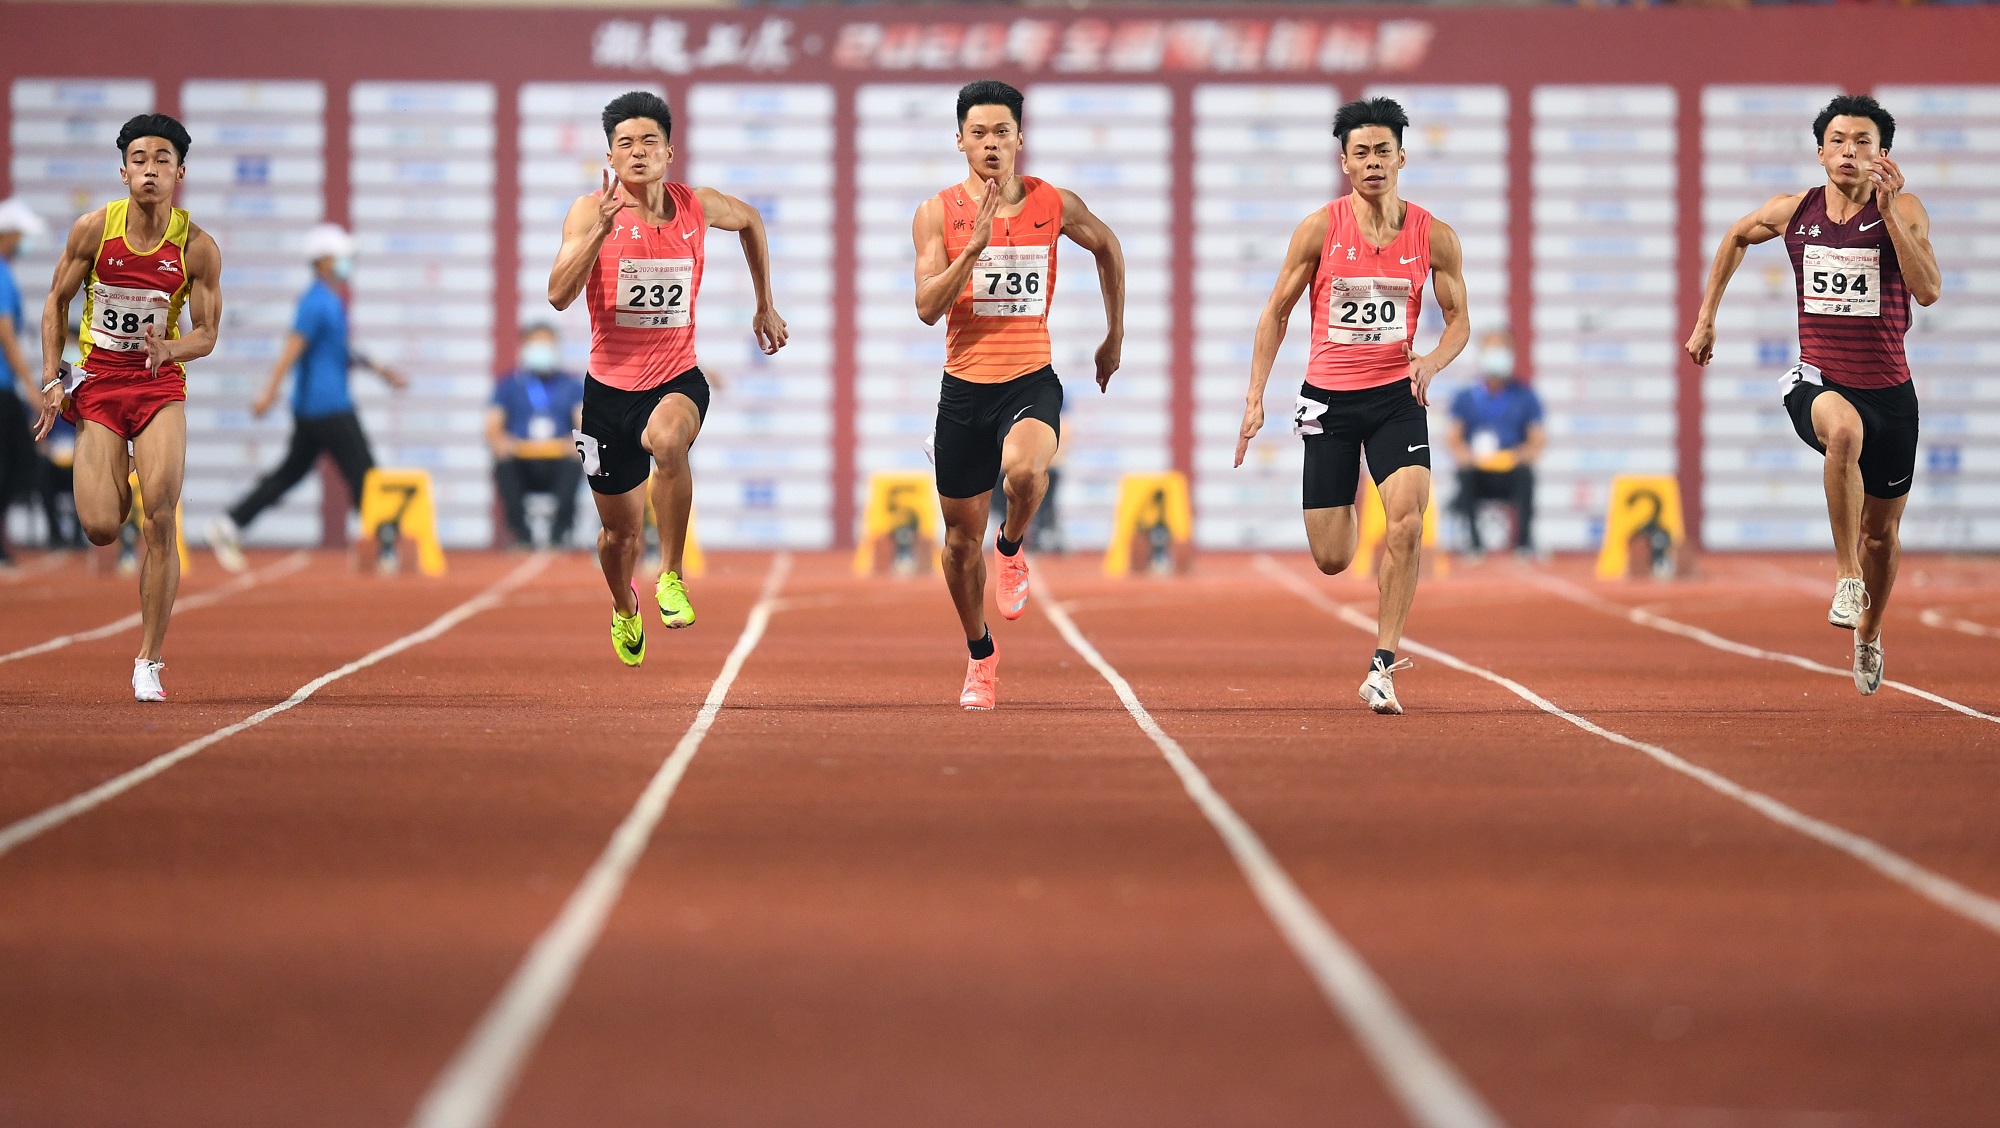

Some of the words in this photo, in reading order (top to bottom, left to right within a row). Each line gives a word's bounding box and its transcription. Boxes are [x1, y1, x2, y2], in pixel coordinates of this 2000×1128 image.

[612, 224, 641, 240] 广东
[1795, 224, 1821, 237] 上海
[1329, 242, 1356, 260] 广东
[985, 272, 1040, 295] 736
[1812, 272, 1868, 295] 594
[628, 284, 683, 307] 232
[1340, 301, 1396, 324] 230
[1792, 363, 1804, 385] 3
[1294, 405, 1308, 428] 4
[380, 484, 418, 528] 7
[886, 485, 920, 533] 5
[1626, 489, 1664, 537] 2
